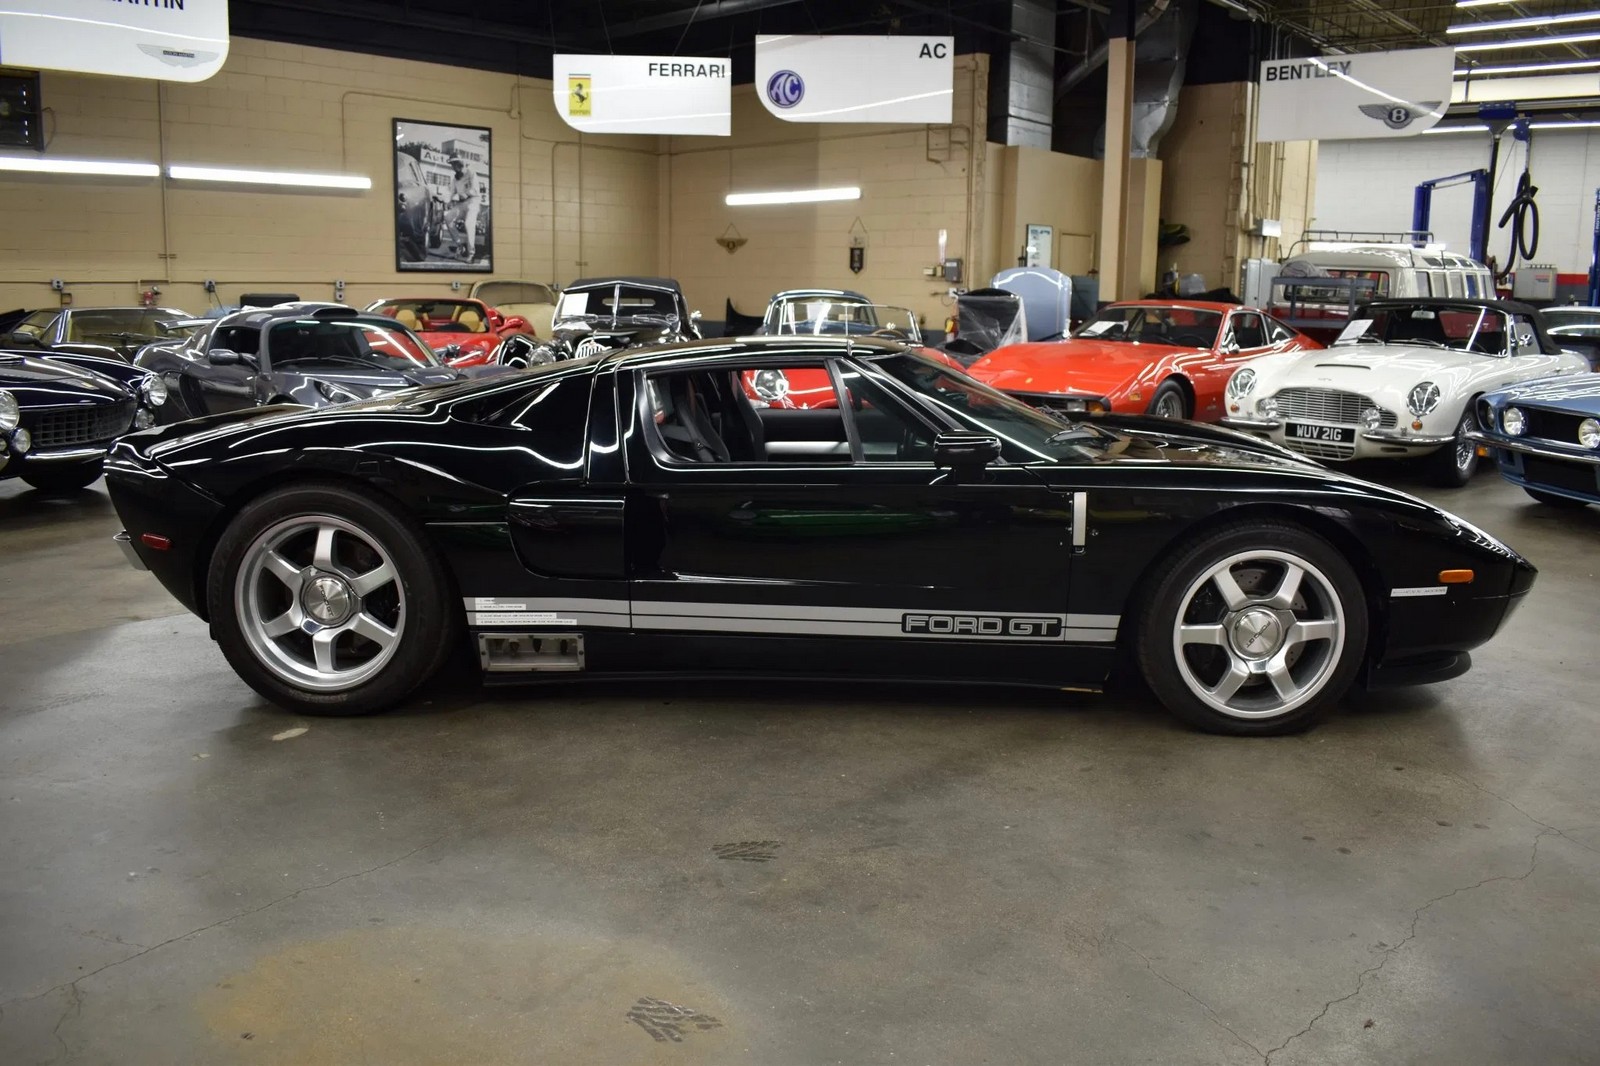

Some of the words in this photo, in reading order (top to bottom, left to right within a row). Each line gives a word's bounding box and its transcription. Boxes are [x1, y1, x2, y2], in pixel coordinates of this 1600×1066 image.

[112, 0, 184, 10] TIN
[918, 43, 947, 59] AC
[648, 63, 725, 78] FERRARI
[1266, 61, 1352, 82] BENTLEY
[770, 73, 800, 105] AC
[1391, 108, 1406, 123] B
[1296, 424, 1320, 439] WUV
[1321, 427, 1342, 441] 21G
[905, 615, 1003, 634] FORD
[1008, 618, 1058, 636] GT
